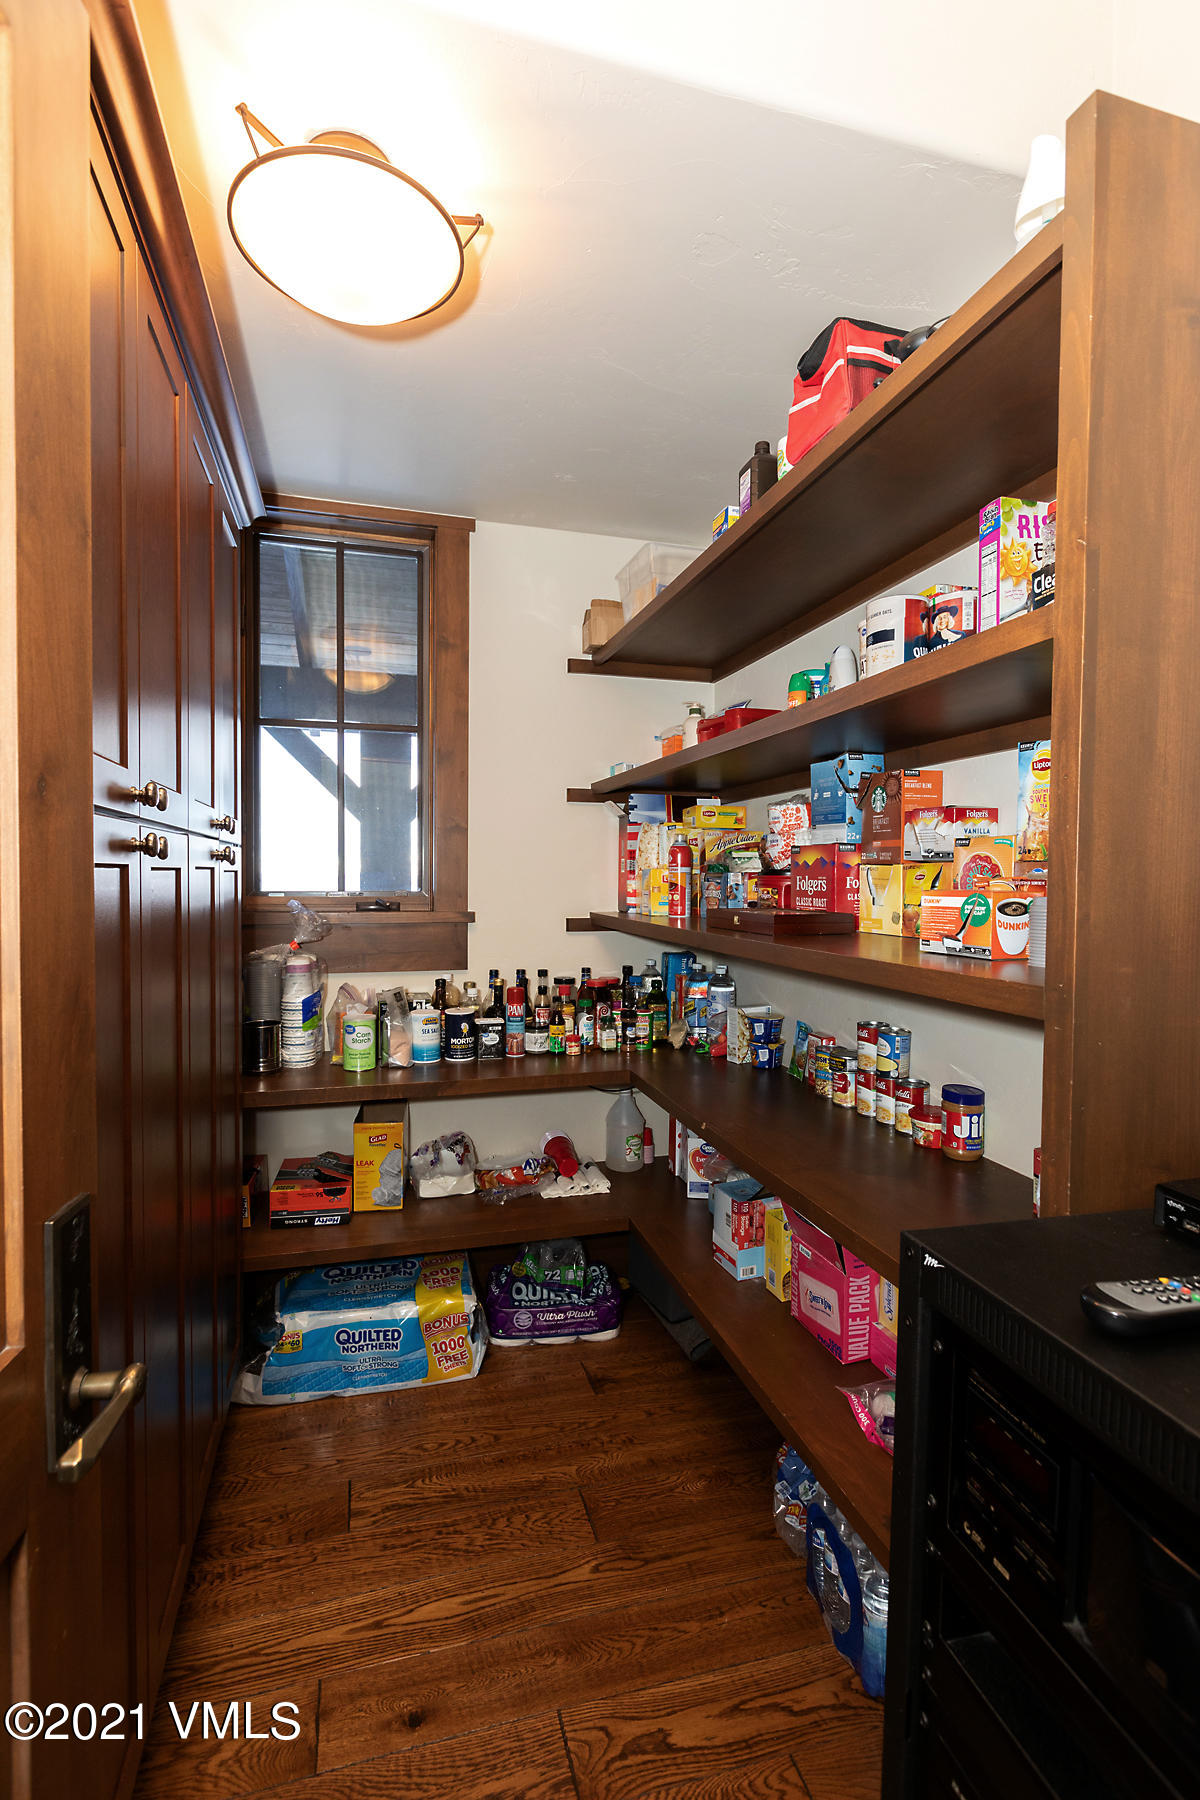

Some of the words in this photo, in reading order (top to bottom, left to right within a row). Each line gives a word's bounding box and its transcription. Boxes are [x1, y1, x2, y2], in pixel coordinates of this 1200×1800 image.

[966, 809, 989, 819] Folgers
[796, 875, 828, 895] Folgers
[795, 897, 812, 906] CLASSIC
[813, 898, 828, 908] ROAST
[507, 1004, 524, 1016] PAM
[351, 1037, 372, 1045] Starch
[369, 1134, 388, 1143] GLAD
[355, 1159, 375, 1167] LEAK
[315, 1217, 341, 1225] Hefty
[791, 1241, 800, 1277] PACK
[322, 1260, 419, 1279] QUILTED
[421, 1267, 461, 1279] 1000
[544, 1269, 561, 1281] 72
[330, 1270, 413, 1284] NORTHERN
[422, 1275, 461, 1287] FREE
[848, 1274, 871, 1313] PACK
[536, 1311, 566, 1321] Ultra
[566, 1308, 597, 1320] Plush
[423, 1312, 471, 1336] BONUS
[335, 1328, 402, 1345] QUILTED
[847, 1315, 870, 1361] VALUE
[340, 1342, 400, 1354] NORTHERN
[430, 1336, 466, 1357] 1000
[358, 1356, 381, 1365] ULTRA
[367, 1360, 399, 1370] STRONG
[436, 1350, 470, 1369] FREE
[443, 1360, 467, 1374] SHEETS
